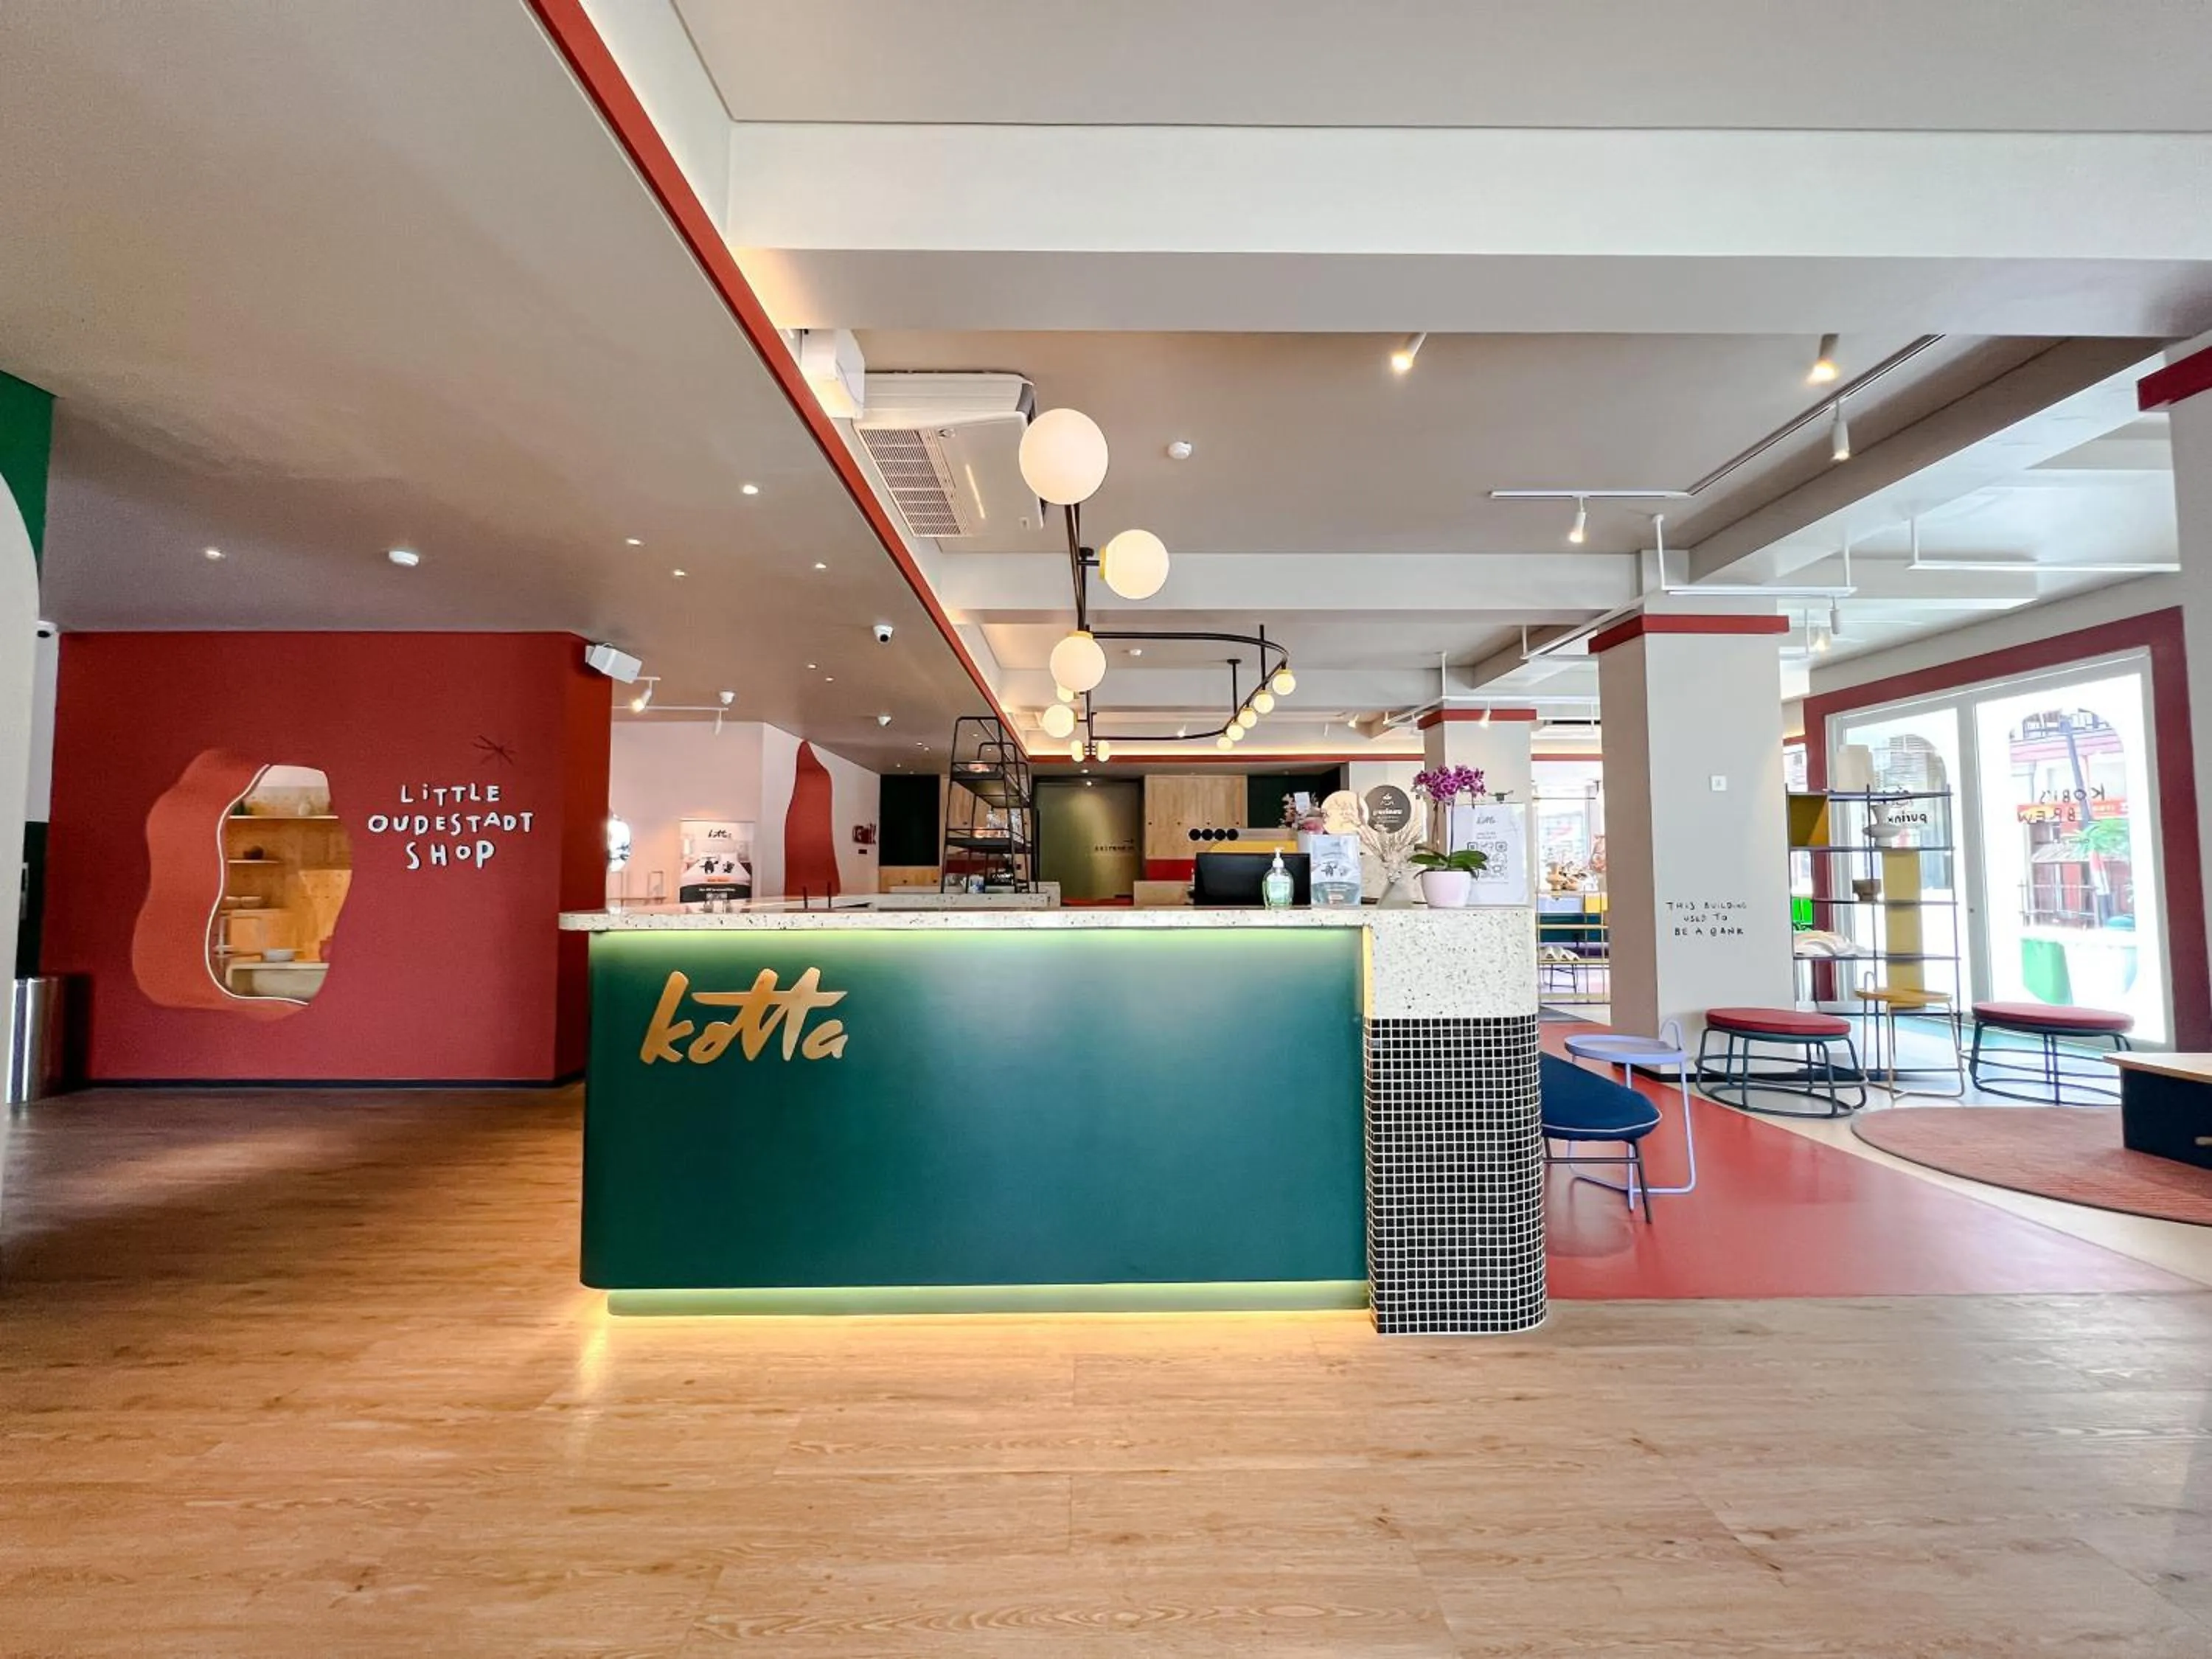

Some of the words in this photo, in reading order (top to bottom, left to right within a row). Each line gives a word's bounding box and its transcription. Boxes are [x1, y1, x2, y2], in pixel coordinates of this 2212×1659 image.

[368, 812, 534, 836] OUDESTADT
[406, 840, 495, 870] SHOP
[1674, 928, 1688, 936] BE
[1710, 927, 1744, 936] BANK
[640, 967, 849, 1065] kotta
